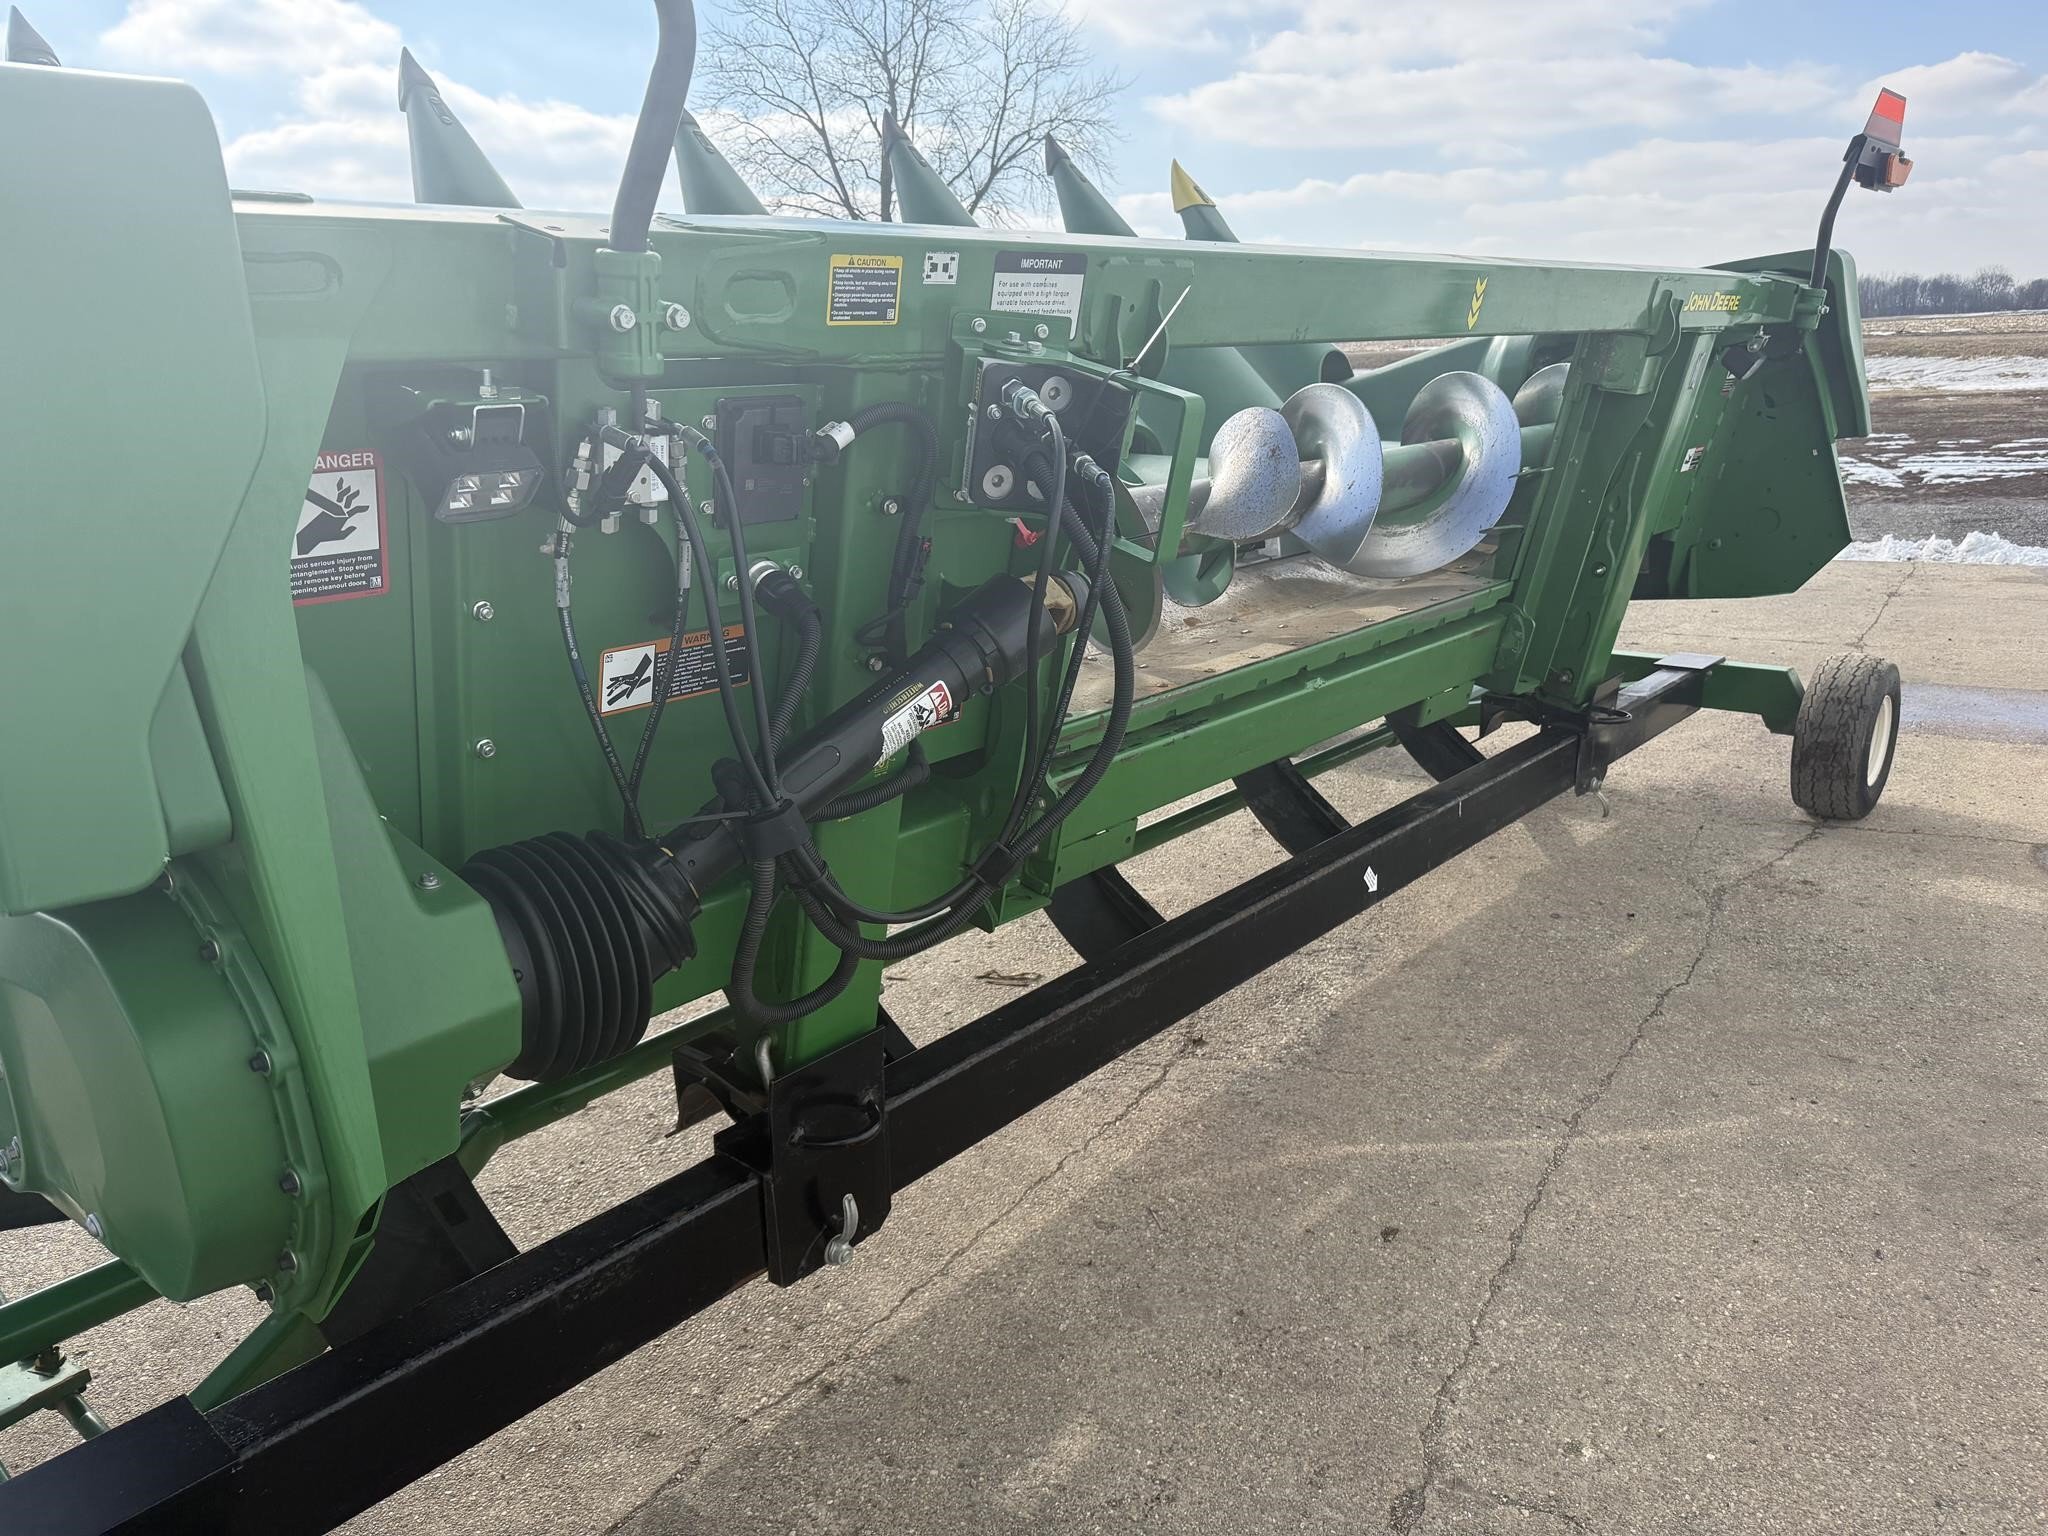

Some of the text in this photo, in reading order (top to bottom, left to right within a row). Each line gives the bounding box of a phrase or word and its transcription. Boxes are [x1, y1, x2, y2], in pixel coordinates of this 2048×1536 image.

[856, 258, 886, 266] CAUTION
[1020, 258, 1063, 269] IMPORTANT
[1683, 291, 1741, 311] JOHN DEERE
[314, 452, 374, 470] ANGER
[319, 582, 347, 591] cleanout
